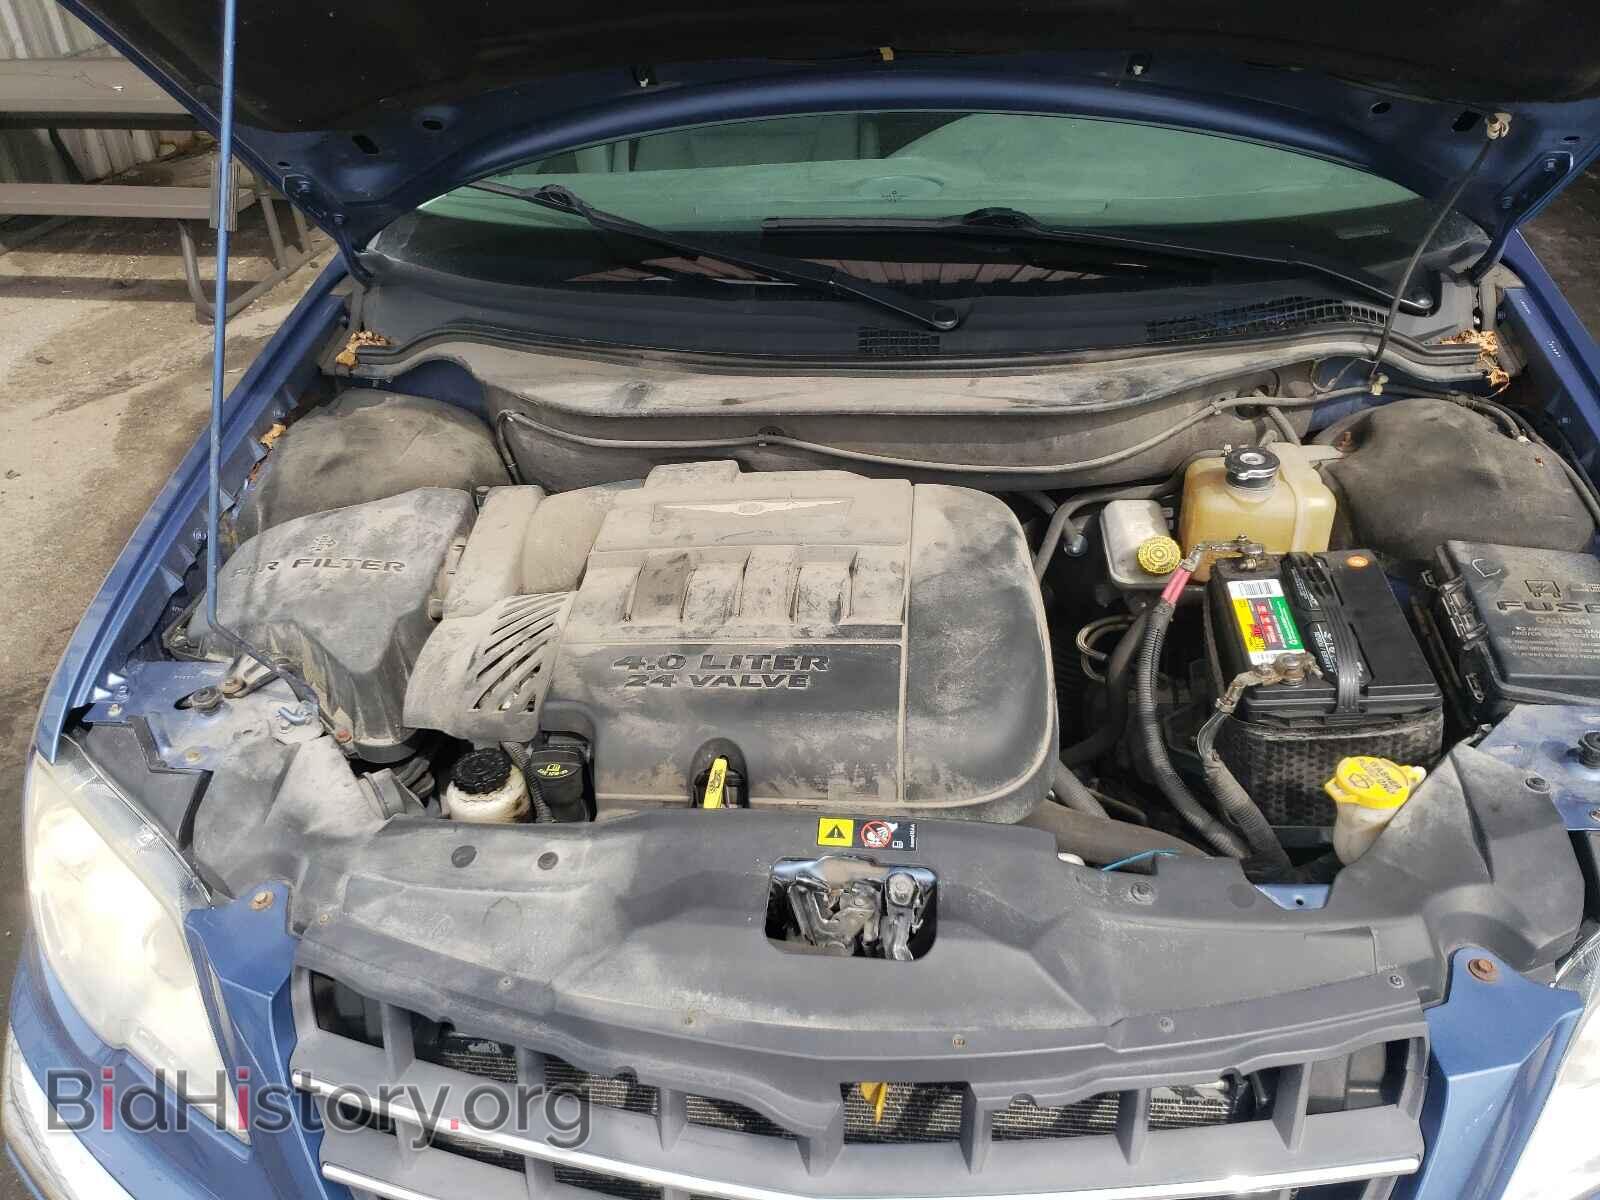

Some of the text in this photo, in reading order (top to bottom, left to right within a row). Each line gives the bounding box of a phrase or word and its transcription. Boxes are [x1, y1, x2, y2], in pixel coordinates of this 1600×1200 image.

[291, 558, 406, 572] FILTER
[611, 654, 830, 672] 4.0 LITER
[624, 674, 811, 689] 24 VALVE
